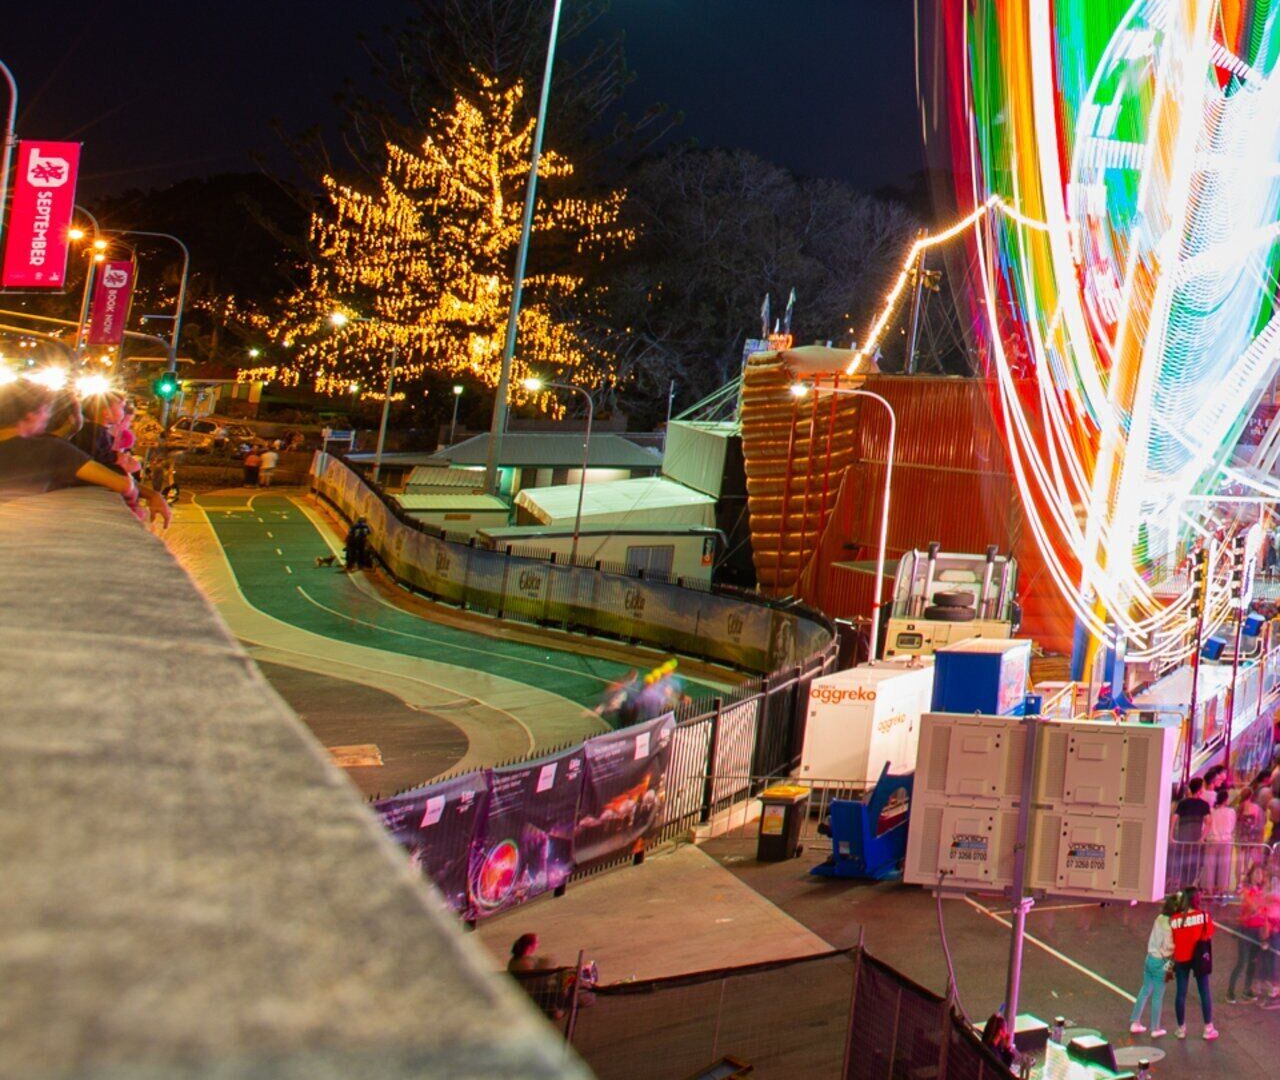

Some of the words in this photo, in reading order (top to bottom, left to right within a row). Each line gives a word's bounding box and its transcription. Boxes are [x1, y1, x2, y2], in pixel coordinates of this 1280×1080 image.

[29, 191, 53, 266] SEPTEMBER
[105, 289, 117, 313] BOOK
[811, 686, 877, 704] aggreko
